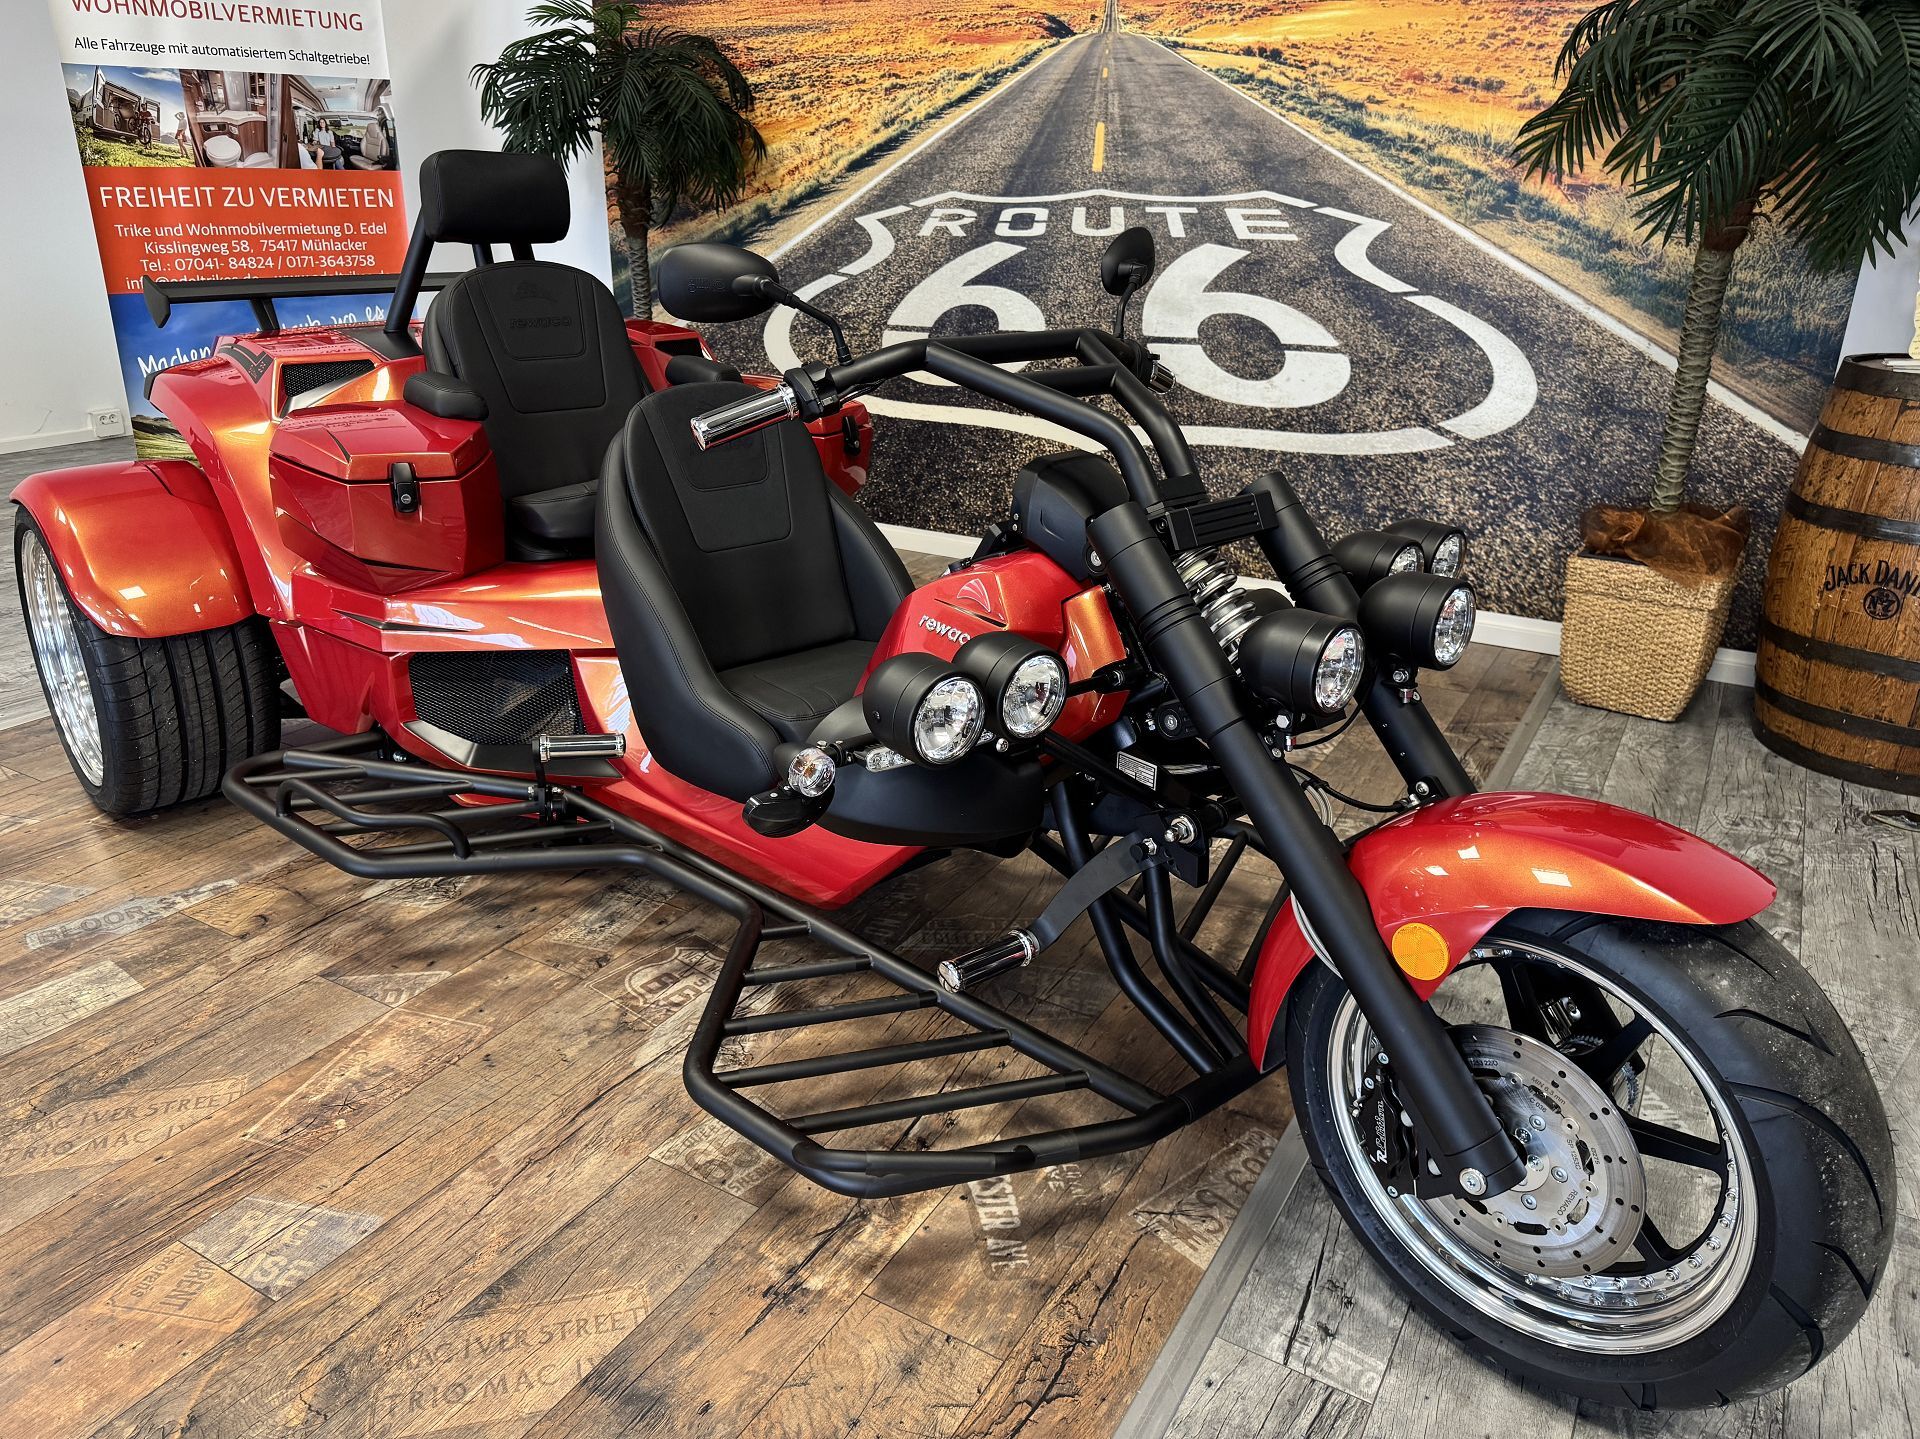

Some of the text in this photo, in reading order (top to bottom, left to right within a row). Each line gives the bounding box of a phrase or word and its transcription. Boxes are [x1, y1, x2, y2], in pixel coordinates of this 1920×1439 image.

[72, 0, 363, 31] WOHNMOBILVERMIETUNG
[74, 37, 371, 66] Alle Fahrzeuge mit automatisiertem Schaltgetriebe!
[99, 186, 395, 208] FREIHEIT ZU VERMIETEN
[114, 221, 388, 238] Trike und Wohnmobilvermietung D. Edel
[919, 206, 1300, 242] ROUTE
[144, 238, 368, 256] Kisslingweg 58, 75417 Mühlacker
[140, 254, 376, 272] Tel.: 07041- 84824 / 0171-3643758
[881, 241, 1352, 408] 66
[1823, 563, 1872, 592] JACK
[135, 1090, 238, 1119] STREET
[1556, 1188, 1579, 1216] REWACO
[536, 1309, 642, 1345] STREET
[482, 1362, 559, 1401] MAC
